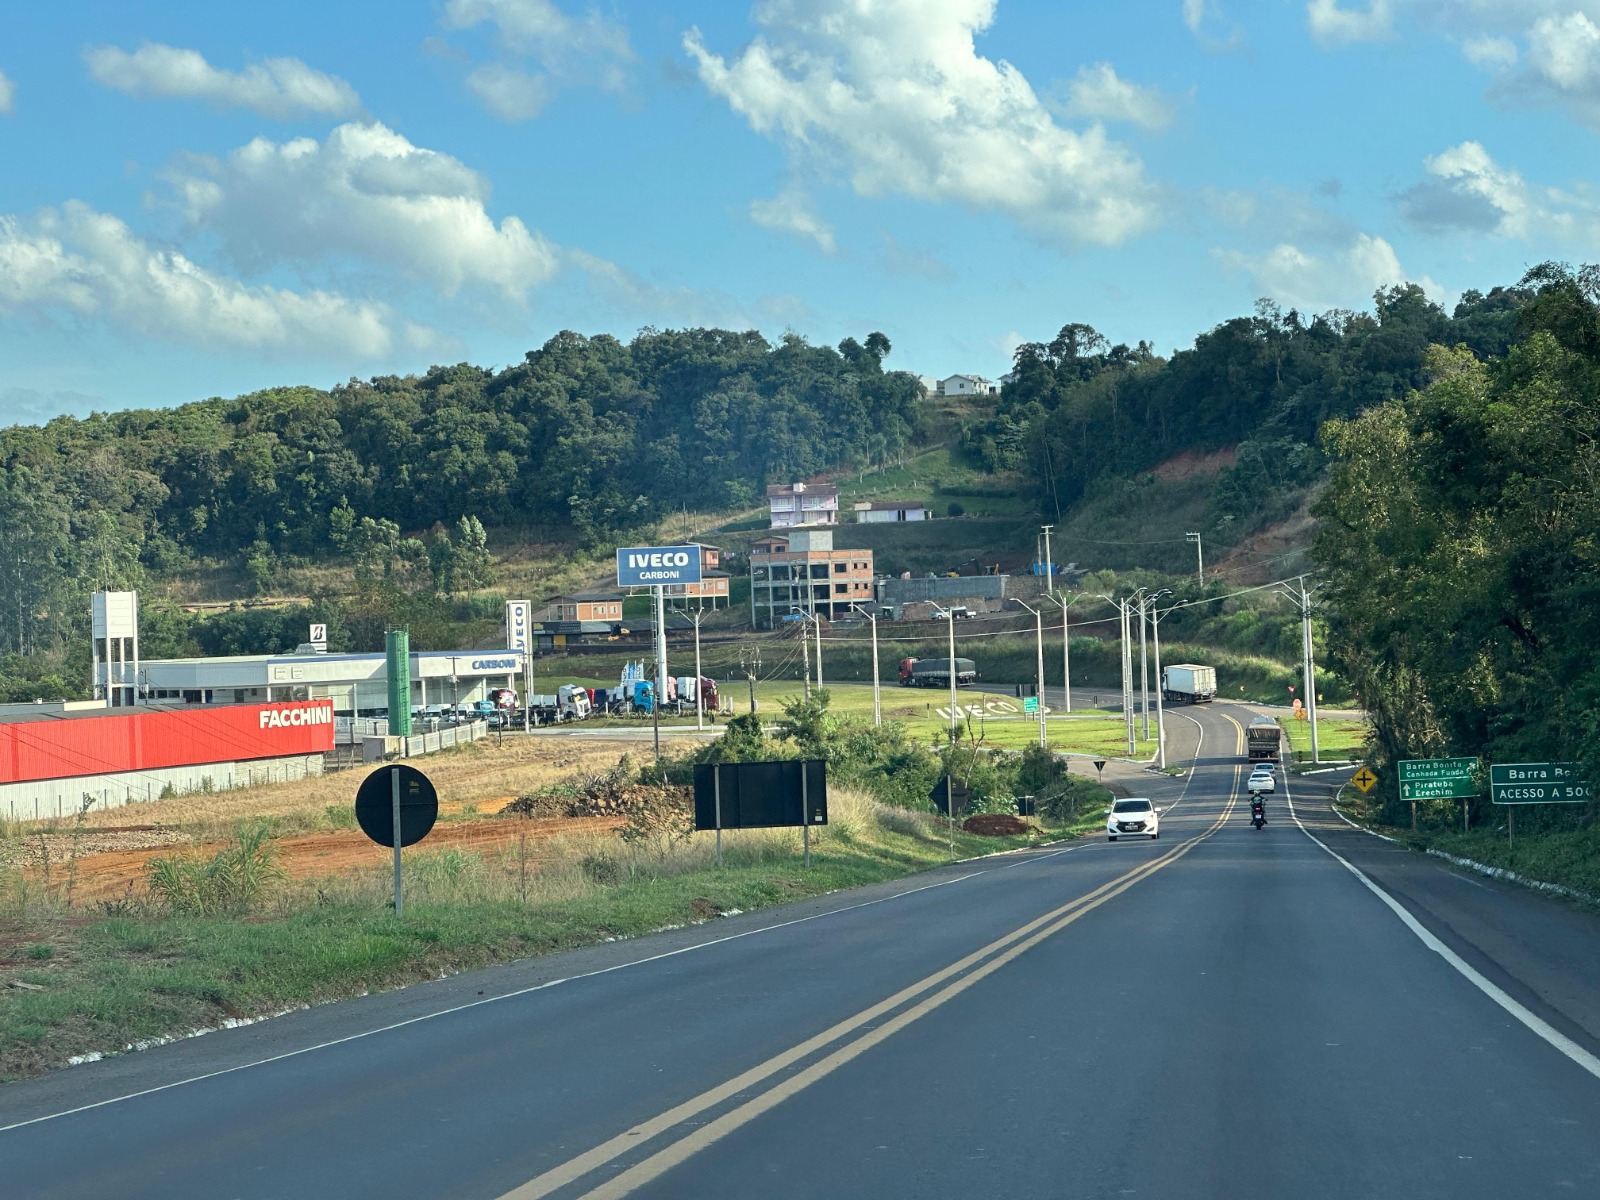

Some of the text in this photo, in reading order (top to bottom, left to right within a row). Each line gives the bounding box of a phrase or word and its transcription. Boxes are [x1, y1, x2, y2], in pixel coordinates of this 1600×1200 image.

[629, 552, 689, 568] IVECO
[640, 570, 680, 580] CARBONI
[515, 606, 524, 648] VECO
[472, 659, 516, 670] CARBONI
[259, 706, 332, 729] FACCHINI
[1508, 769, 1547, 779] Barra
[1415, 781, 1453, 789] Piratuba
[1415, 788, 1453, 797] Erechim
[1499, 788, 1544, 799] ACESSO
[1552, 787, 1560, 797] A
